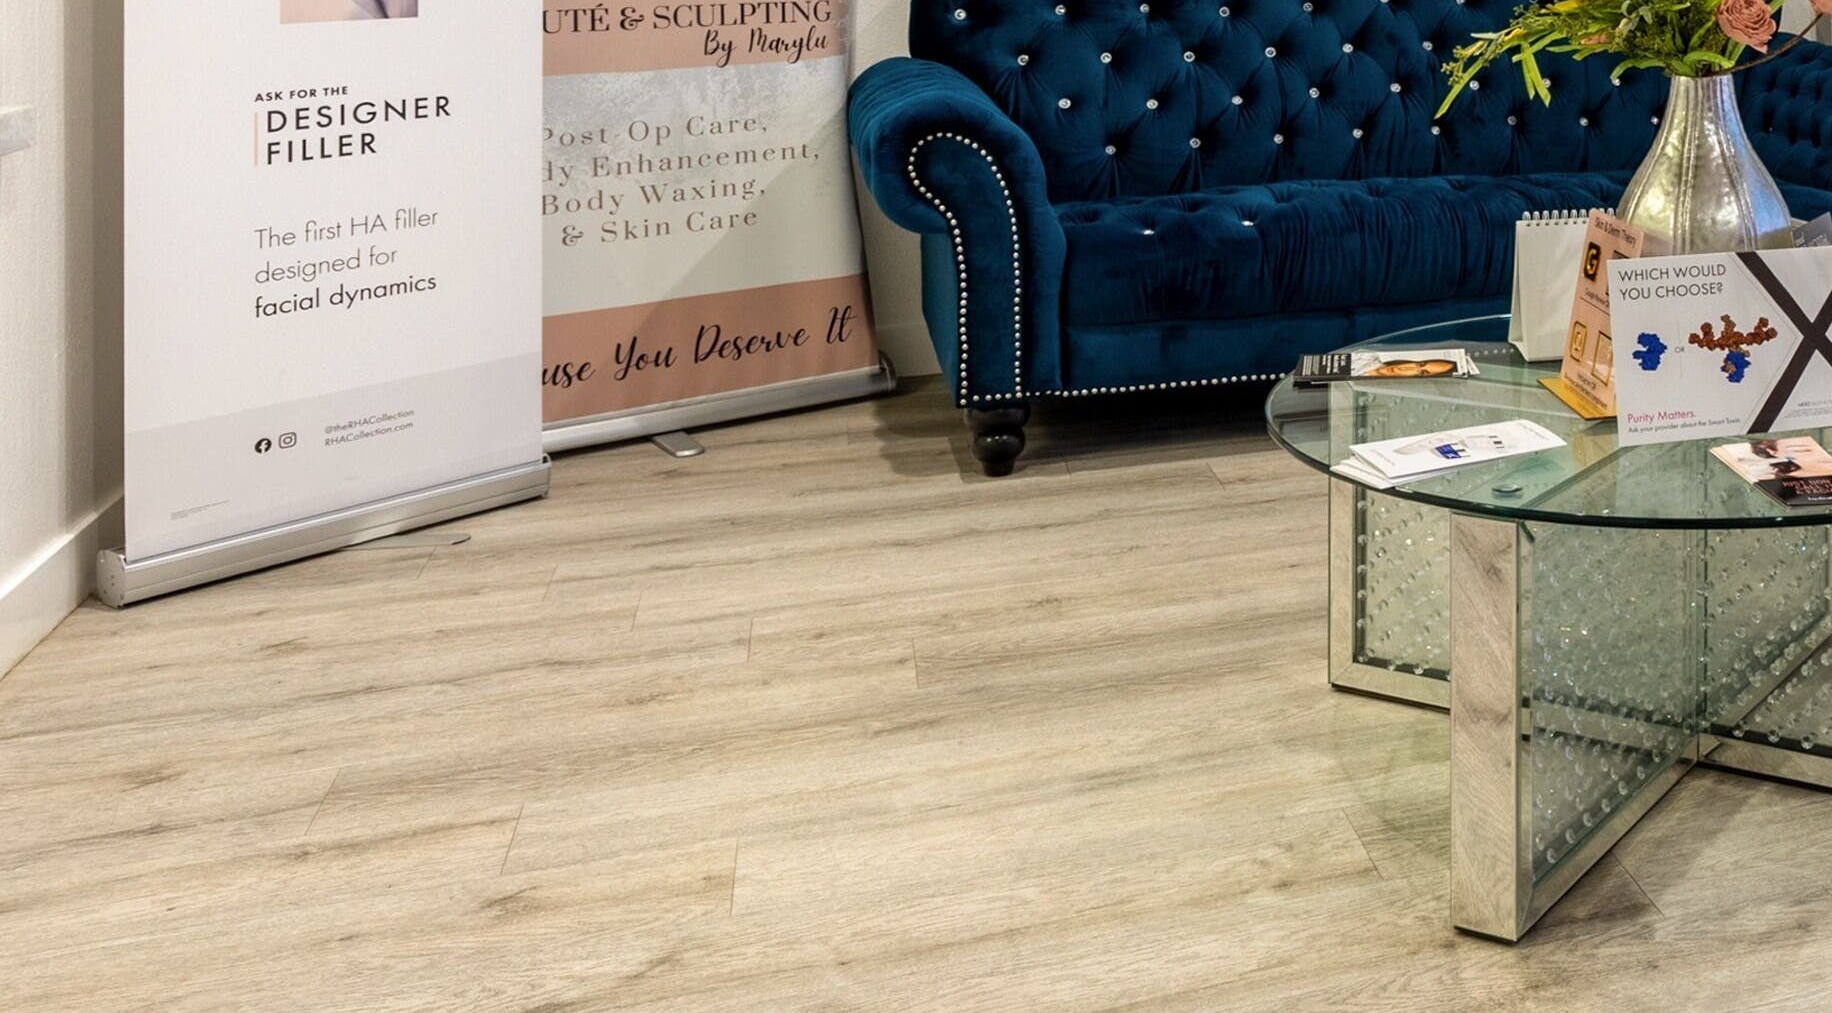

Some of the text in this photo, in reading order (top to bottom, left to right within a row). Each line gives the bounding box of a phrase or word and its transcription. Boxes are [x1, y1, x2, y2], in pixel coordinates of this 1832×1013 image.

[620, 6, 645, 31] &
[653, 0, 831, 29] SCULPTING
[704, 25, 828, 68] By Marylu
[254, 86, 348, 103] ASK FOR THE
[267, 96, 451, 133] DESIGNER
[686, 115, 767, 138] Care,
[267, 133, 377, 165] FILLER
[592, 143, 819, 178] Enhancement,
[542, 179, 765, 215] Body Waxing,
[254, 207, 438, 249] The first HA filler
[561, 210, 757, 247] & Skin Care
[255, 245, 398, 284] designed for
[1618, 264, 1726, 281] WHICH WOULD
[255, 276, 437, 318] facial dynamics
[1619, 287, 1651, 301] YOU
[1655, 281, 1723, 299] CHOOSE?
[614, 336, 677, 381] You
[694, 324, 811, 364] Deserve
[826, 305, 857, 345] It
[325, 410, 414, 434] @theRHACollection
[1627, 410, 1696, 424] Purity Matters.
[1628, 425, 1638, 433] Ask
[1640, 425, 1653, 434] your
[1654, 424, 1679, 433] provider
[1680, 421, 1697, 429] about
[325, 422, 413, 446] RHACollection.com
